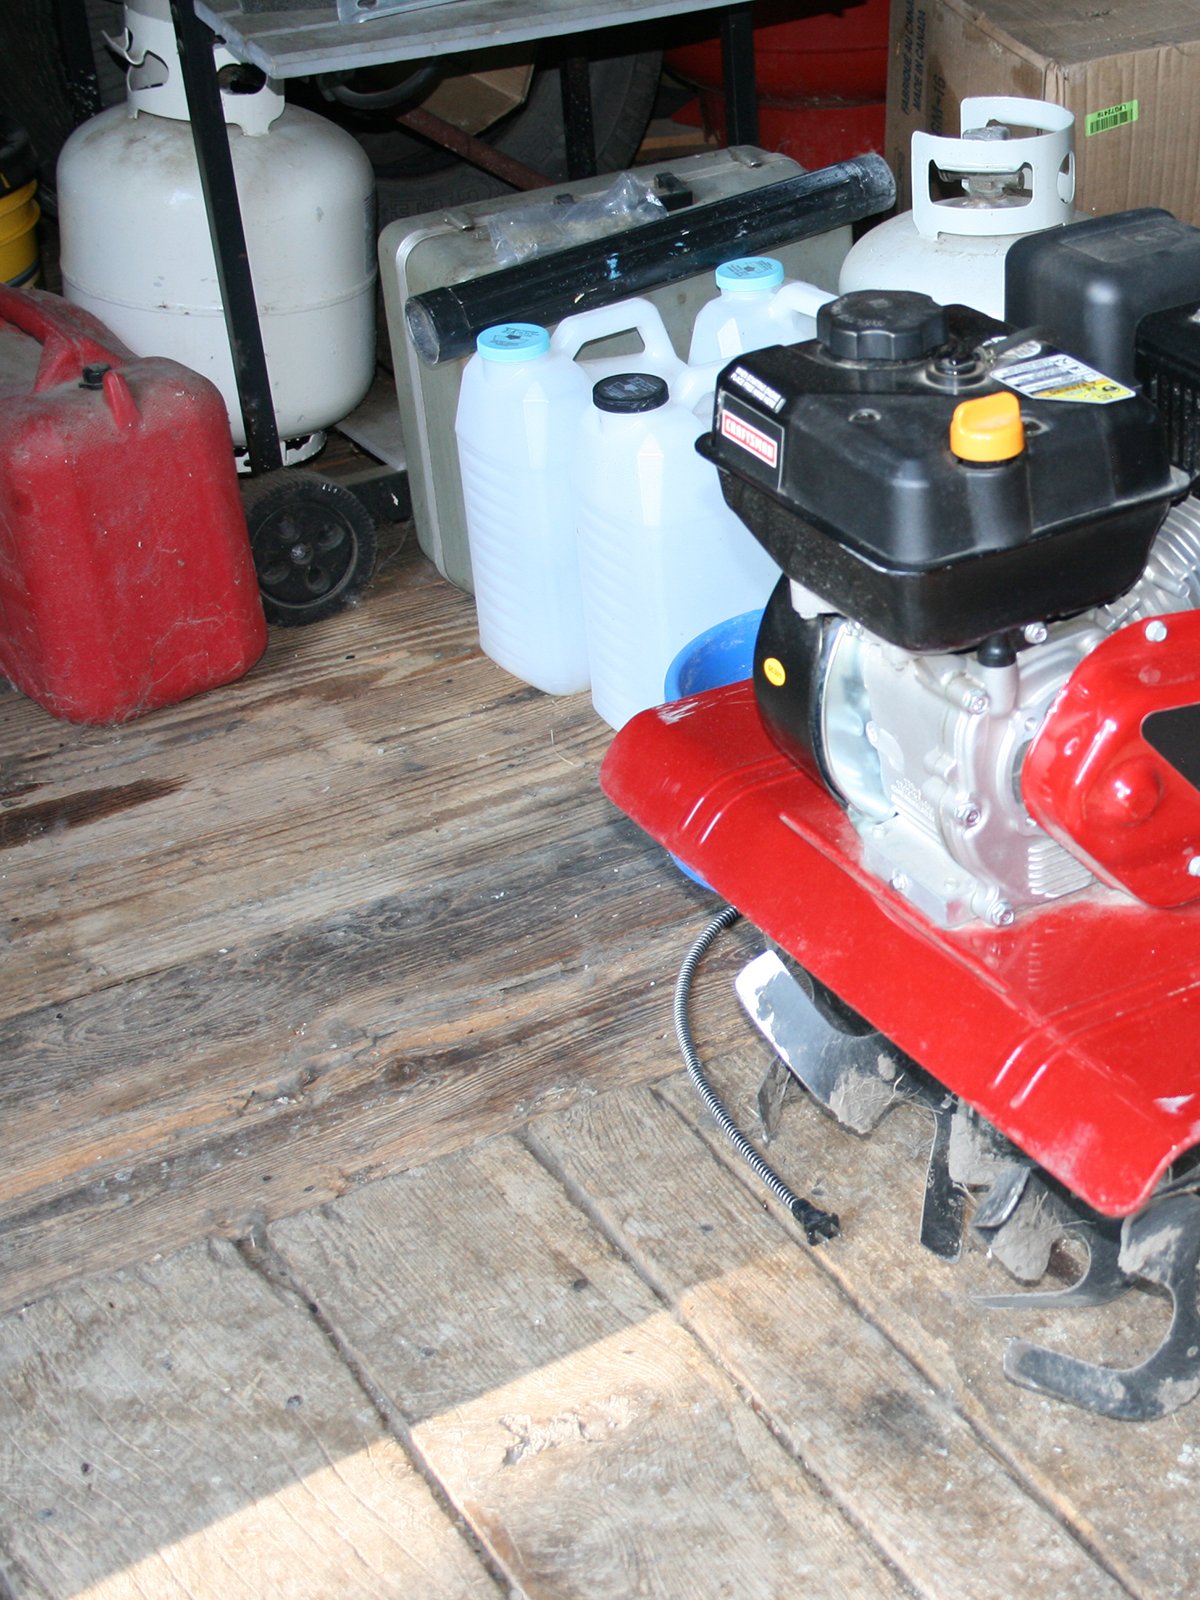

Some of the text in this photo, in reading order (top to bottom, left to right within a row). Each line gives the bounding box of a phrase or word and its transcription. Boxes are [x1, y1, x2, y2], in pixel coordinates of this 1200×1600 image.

[901, 0, 914, 116] FABRIQUE AU CANA
[912, 10, 926, 112] MADE IN CANADA
[725, 417, 774, 460] CRAFTSMAN
